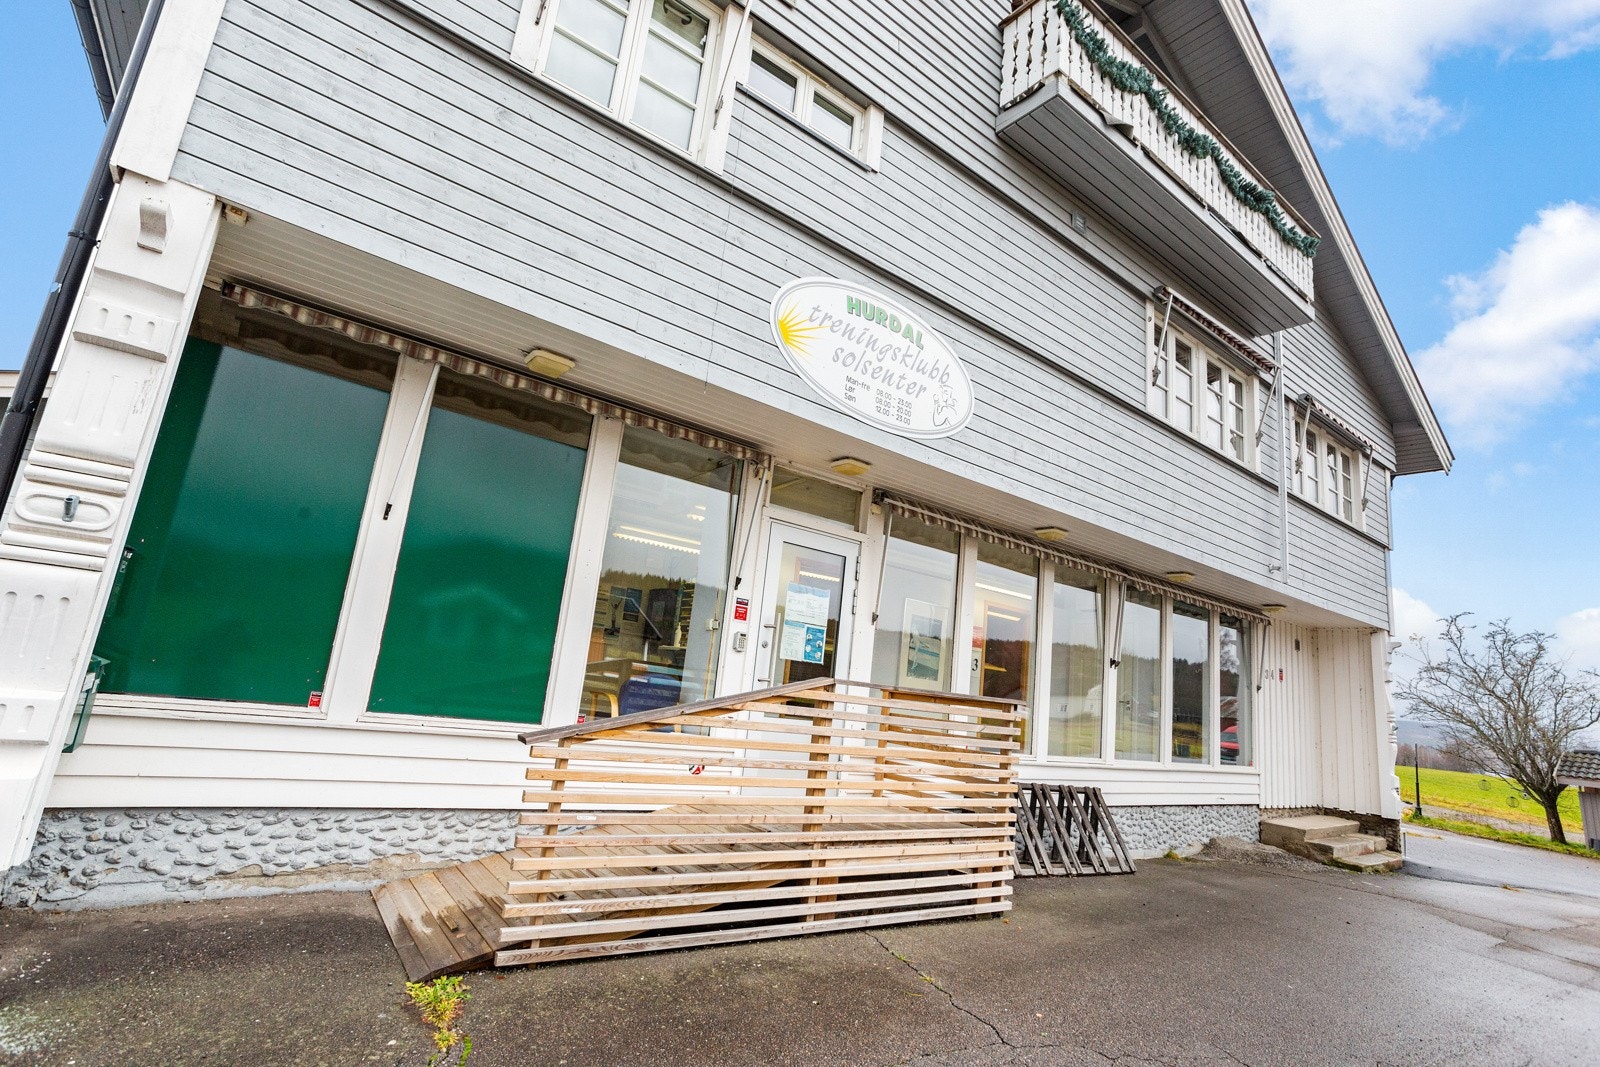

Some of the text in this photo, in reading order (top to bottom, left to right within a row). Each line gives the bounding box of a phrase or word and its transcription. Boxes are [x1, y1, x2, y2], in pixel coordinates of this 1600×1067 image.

[808, 304, 950, 385] treningsklubb
[846, 294, 925, 351] HURDAL
[832, 346, 927, 399] solsenter
